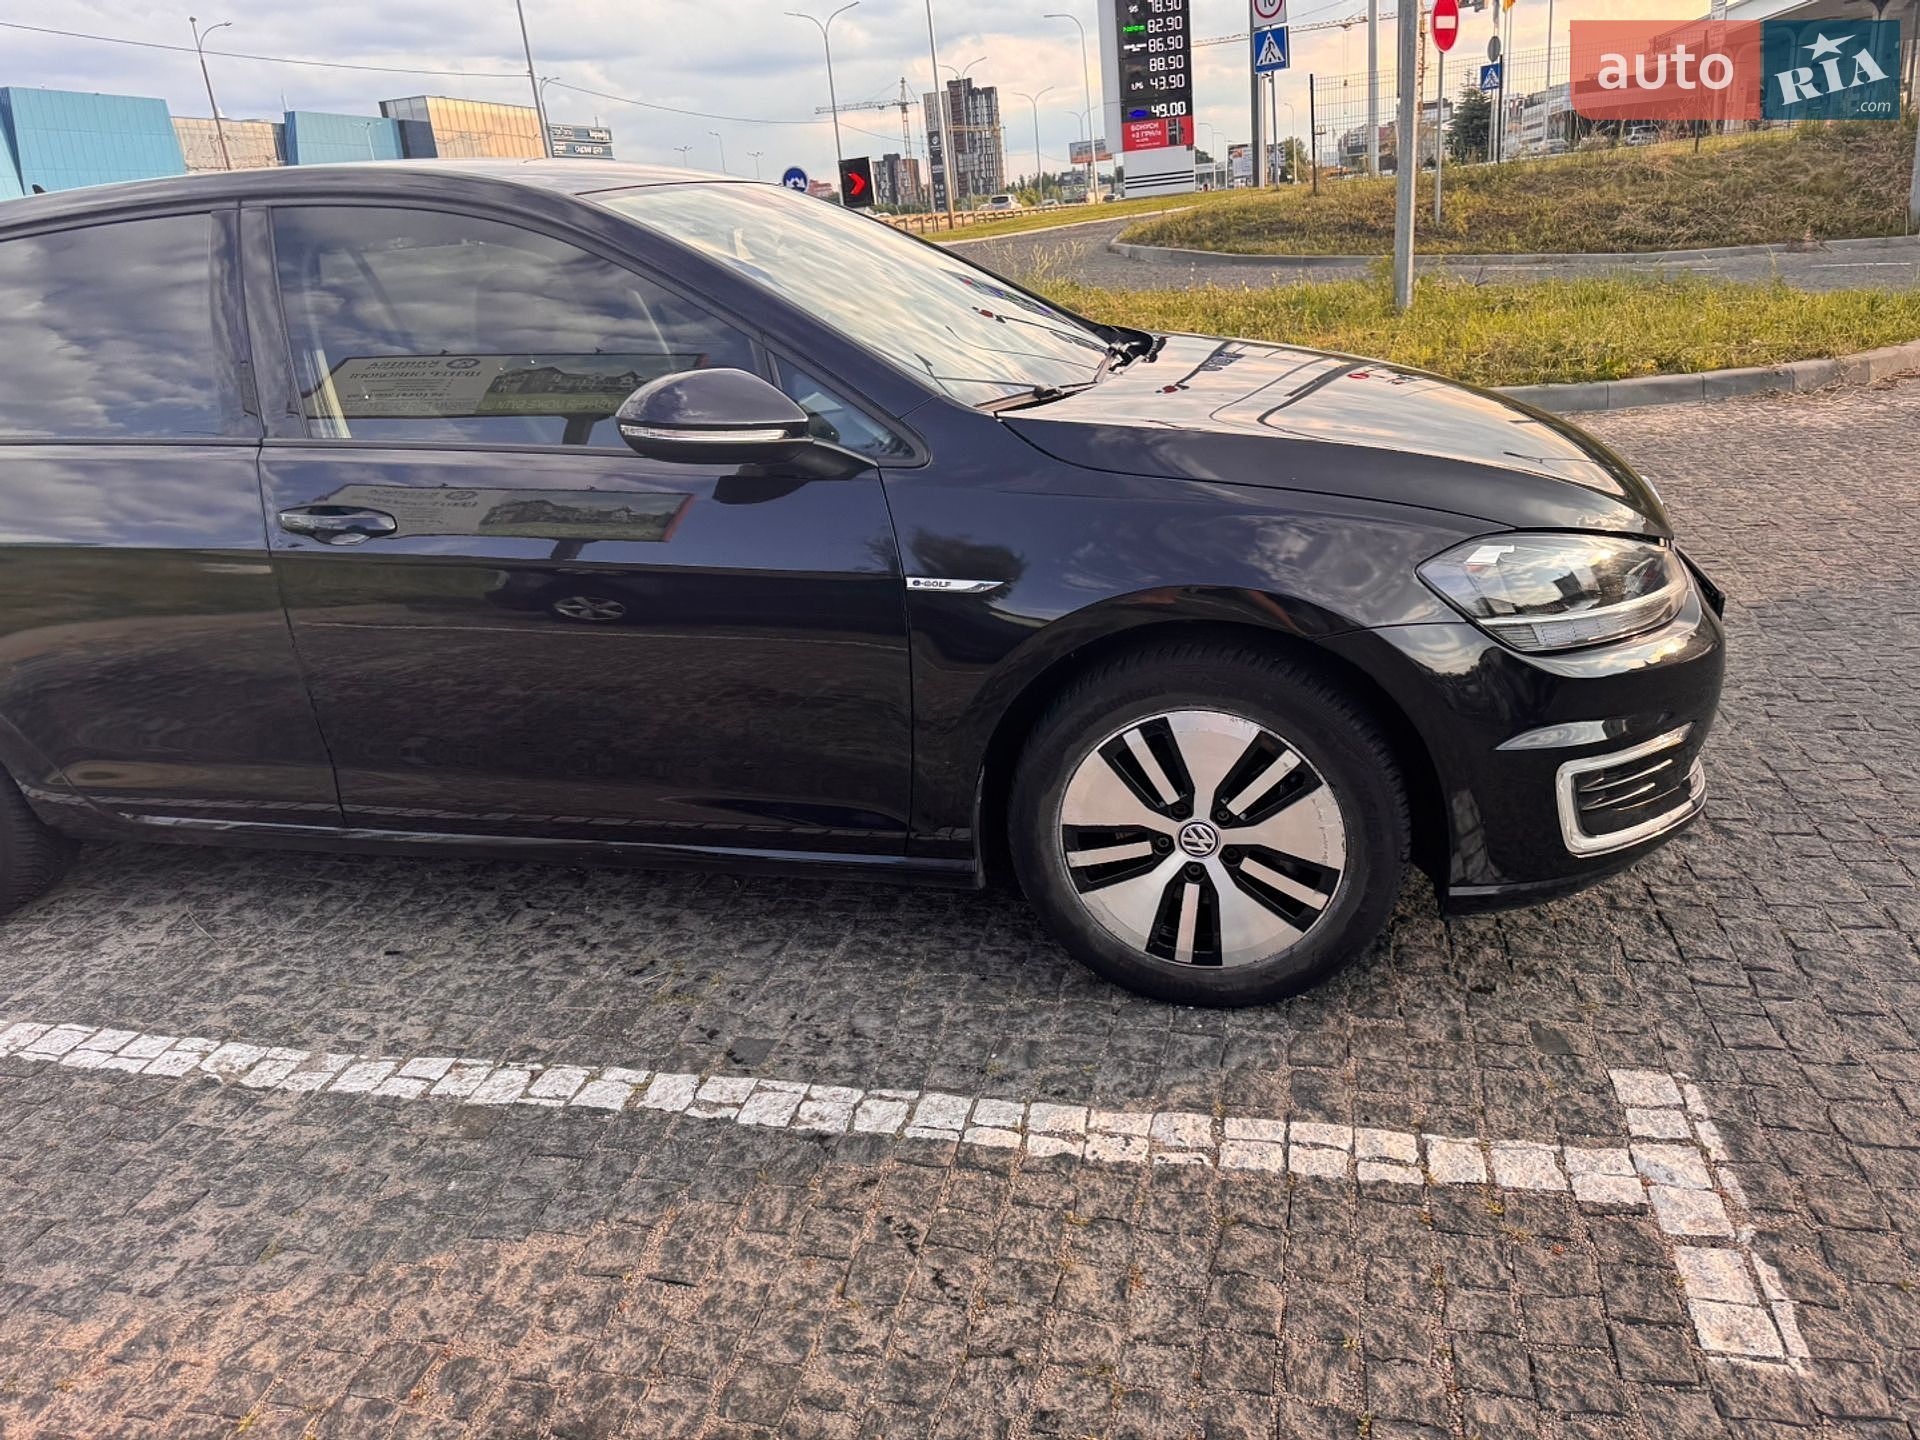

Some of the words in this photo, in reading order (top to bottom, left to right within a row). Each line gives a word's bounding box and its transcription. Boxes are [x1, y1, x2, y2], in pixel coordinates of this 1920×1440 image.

[1147, 16, 1183, 33] 82.90
[1148, 35, 1183, 52] 86.90
[1149, 55, 1184, 72] 88.90
[1150, 74, 1185, 90] 43.90
[1151, 101, 1186, 117] 49.00
